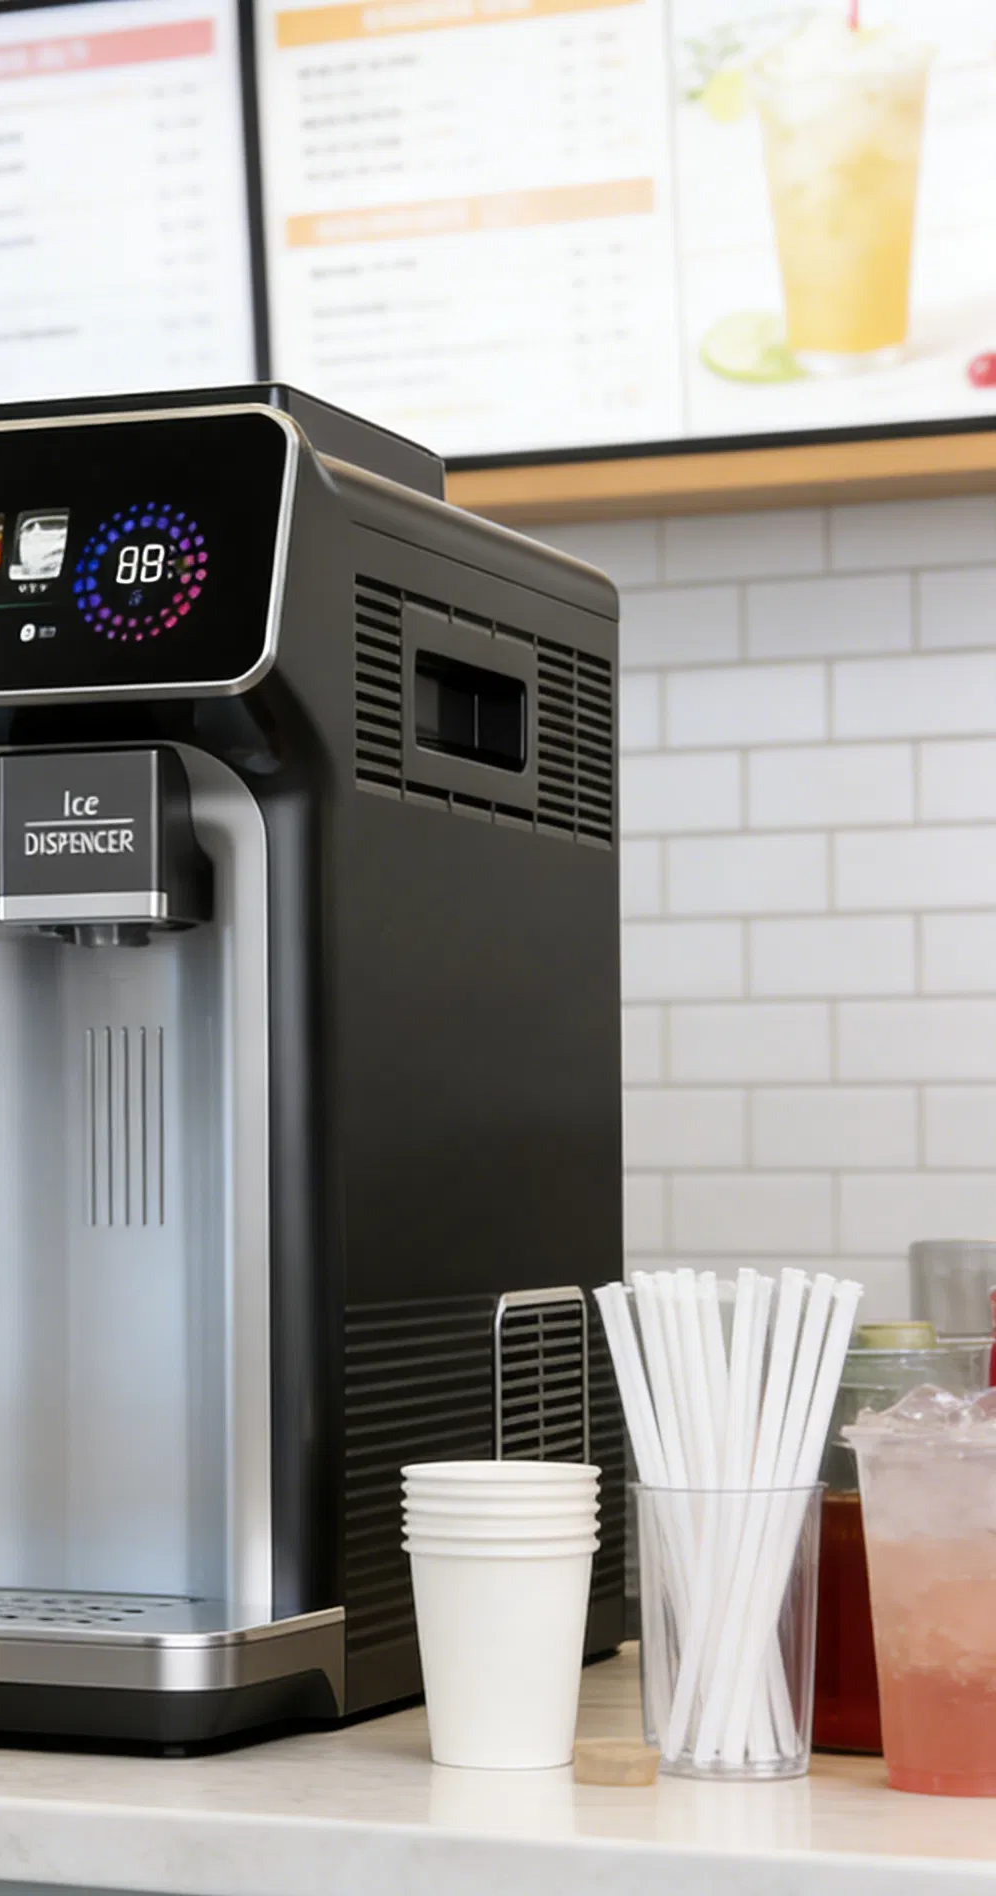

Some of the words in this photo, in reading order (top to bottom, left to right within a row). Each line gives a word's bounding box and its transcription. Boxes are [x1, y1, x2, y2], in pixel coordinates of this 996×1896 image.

[116, 543, 165, 584] 88
[63, 790, 99, 817] Ice
[24, 829, 134, 856] DISPENCER
